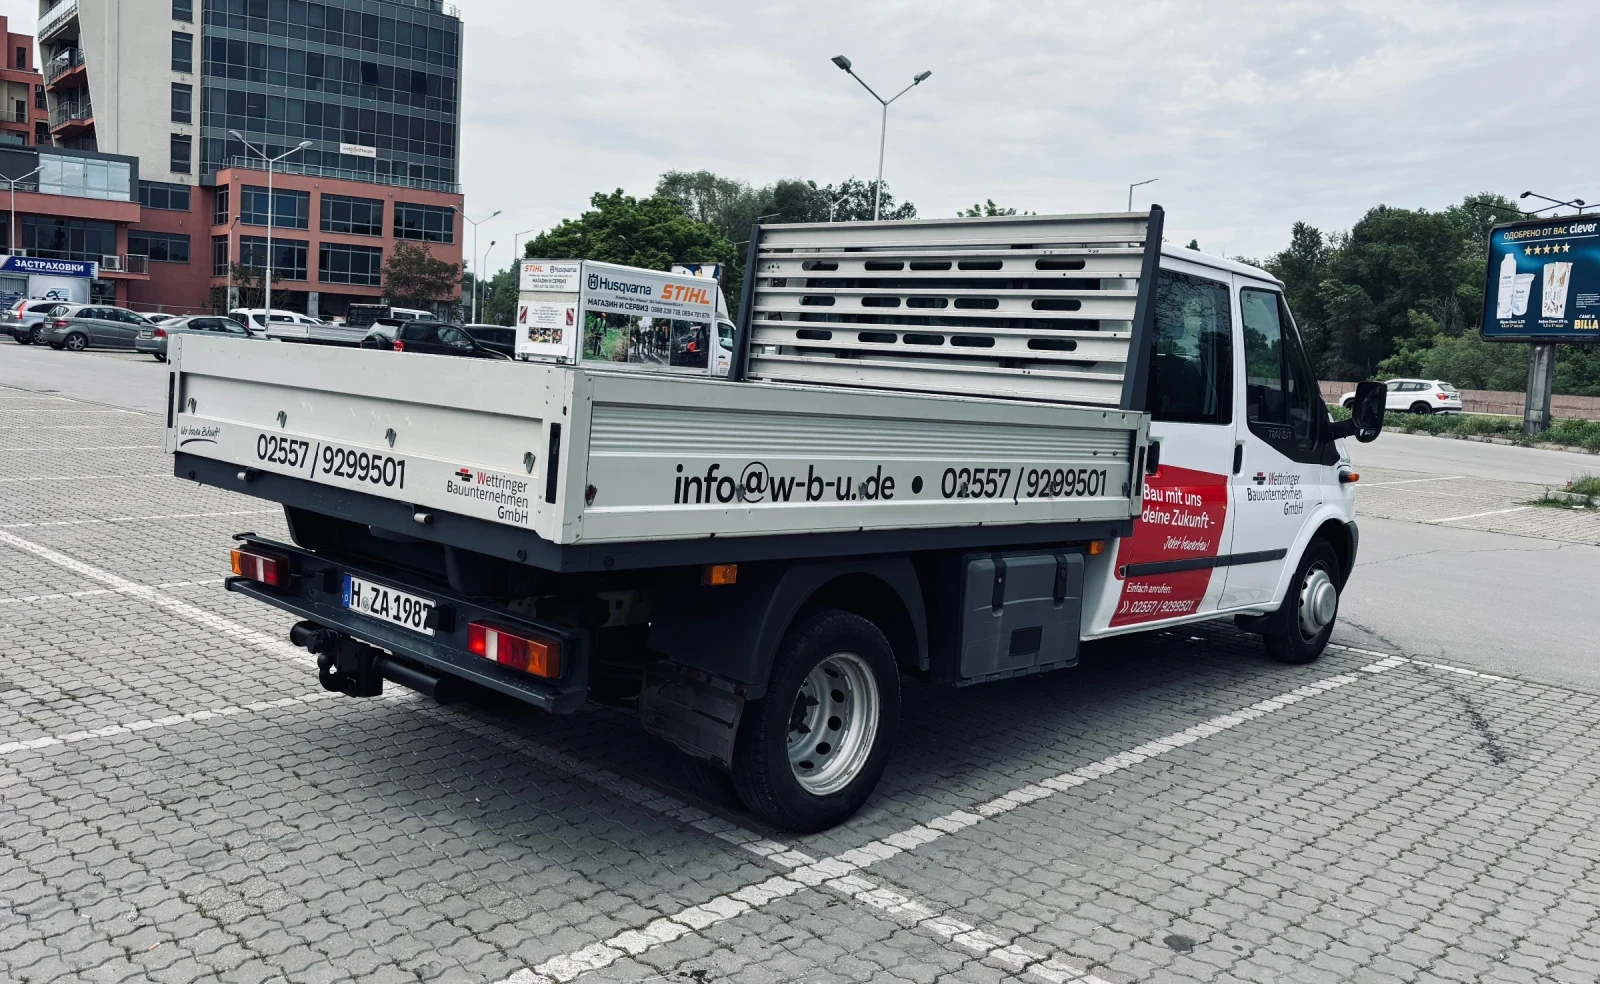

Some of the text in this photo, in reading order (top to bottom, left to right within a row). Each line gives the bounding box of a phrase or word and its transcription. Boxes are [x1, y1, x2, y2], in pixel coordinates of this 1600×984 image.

[1504, 223, 1597, 240] ОДОБРЕНО ОТ ВАС clever
[15, 259, 84, 272] ЗАСТРАХОВКИ
[600, 277, 652, 296] Husqvarna
[661, 284, 710, 304] STIHL
[588, 298, 618, 308] МАГАЗИН
[619, 301, 624, 309] И
[625, 302, 649, 312] СЕРВИЗ
[1574, 319, 1599, 330] BILLA
[1268, 429, 1292, 440] TRANSIT
[257, 433, 309, 468] 02557
[322, 445, 405, 489] 9299501
[477, 471, 528, 496] Wettringer
[674, 461, 895, 504] info@w-b-u.de
[941, 467, 1011, 499] 02557
[1026, 468, 1107, 498] 9299501
[1268, 471, 1300, 489] Wettringer
[446, 480, 529, 509] Bauunternehmen
[1143, 483, 1202, 507] Bau mit uns
[1247, 486, 1303, 502] Bauunternehmen
[497, 506, 529, 525] GmbH
[1142, 504, 1170, 525] deine
[1171, 509, 1209, 529] Zukunft
[1284, 501, 1304, 515] GmbH
[350, 580, 362, 608] H
[1126, 582, 1173, 594] Einfach anrufen:
[1130, 600, 1158, 613] 02557
[1161, 600, 1195, 612] 9299501
